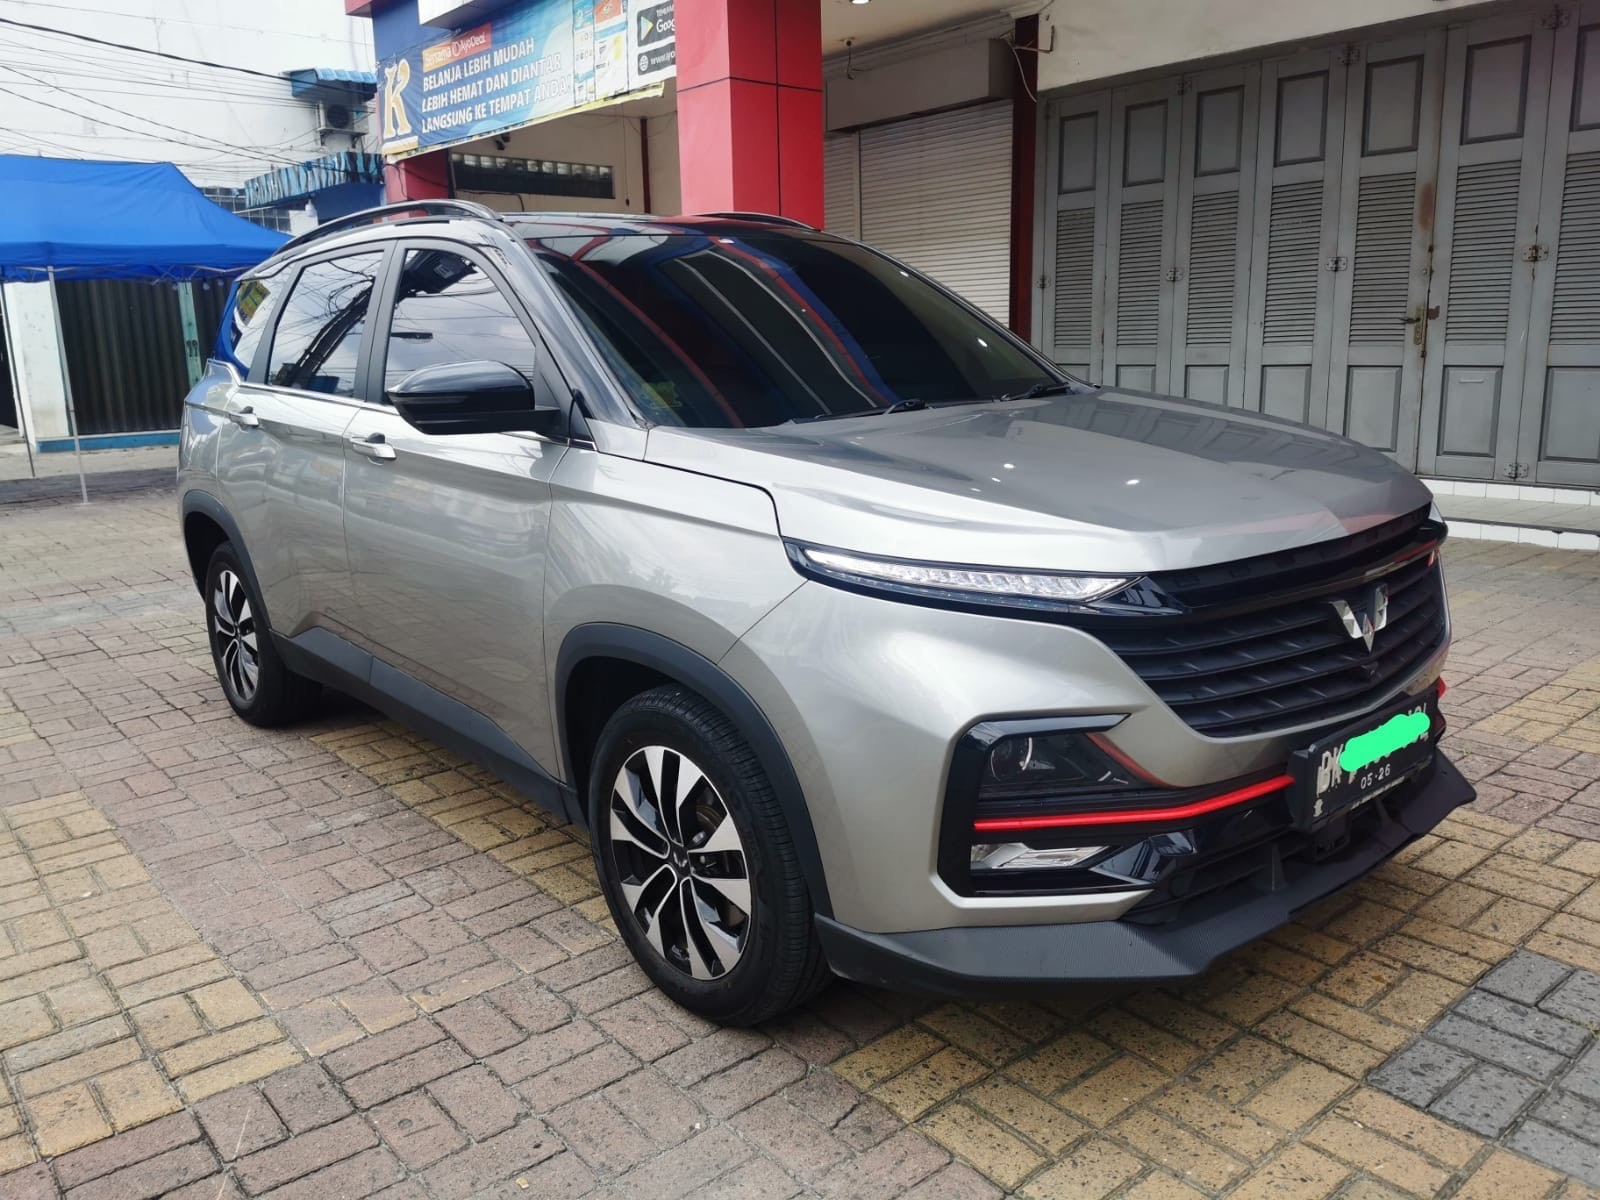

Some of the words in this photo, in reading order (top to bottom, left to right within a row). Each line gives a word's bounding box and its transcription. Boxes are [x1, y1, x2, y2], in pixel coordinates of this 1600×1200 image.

[421, 94, 449, 113] LEBIH
[450, 80, 483, 106] HEMAT
[486, 71, 509, 94] DAN
[511, 53, 561, 85] DIANTAR
[423, 65, 463, 92] BELANJA
[463, 52, 491, 78] LEBIH
[493, 37, 534, 67] MUDAH
[421, 109, 473, 134] LANGSUNG
[474, 104, 487, 121] KE
[489, 90, 531, 116] TEMPAT
